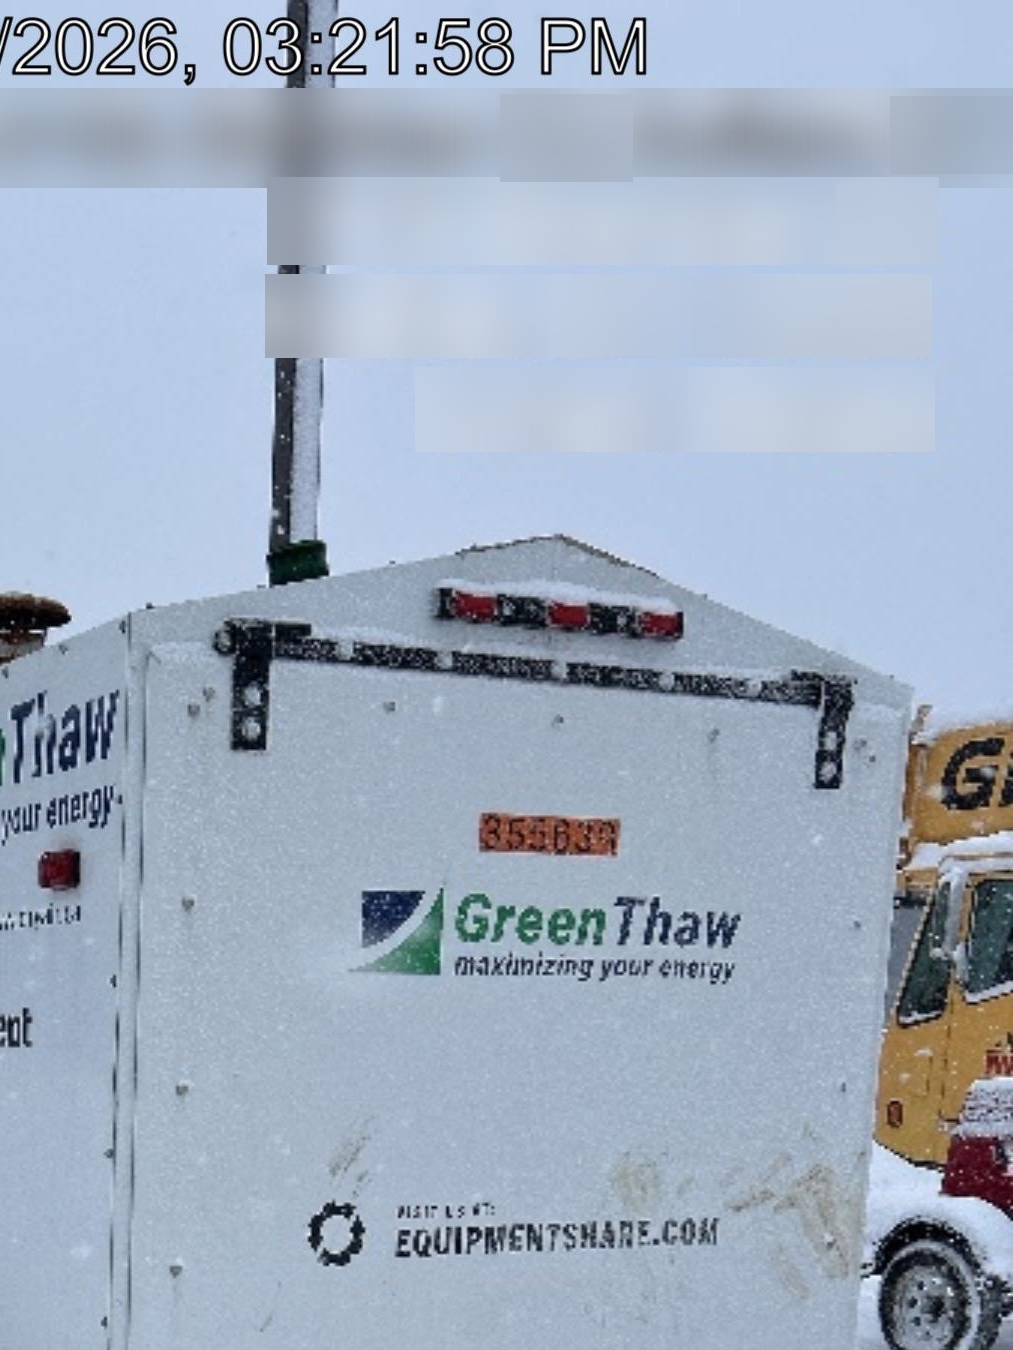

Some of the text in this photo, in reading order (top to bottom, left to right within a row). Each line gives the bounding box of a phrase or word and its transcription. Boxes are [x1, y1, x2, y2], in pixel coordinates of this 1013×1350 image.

[2, 803, 41, 847] your
[454, 950, 735, 985] maximizing your energy
